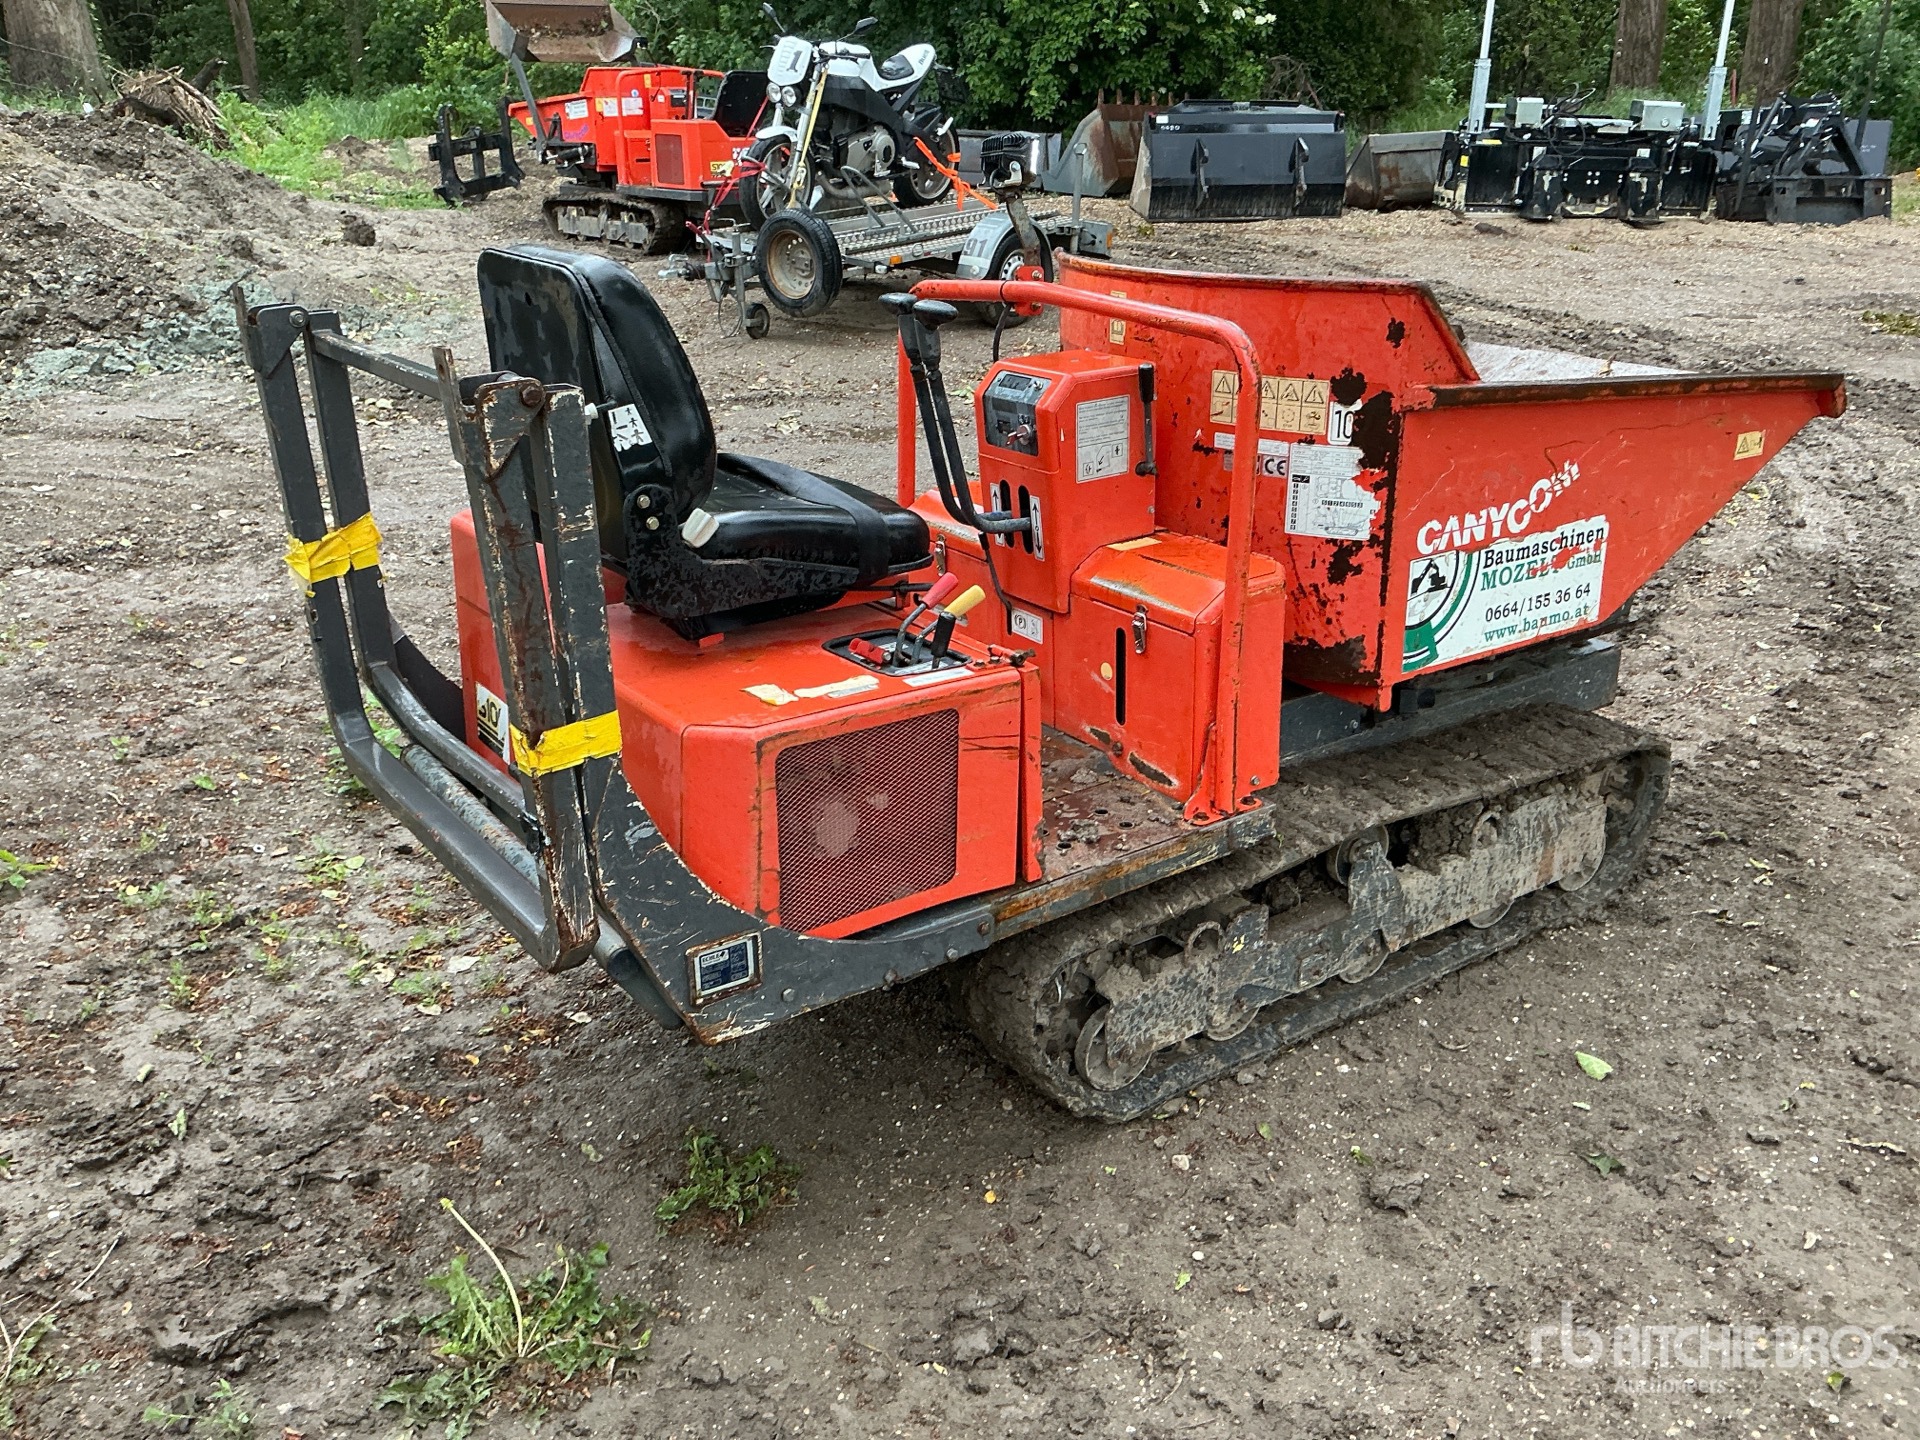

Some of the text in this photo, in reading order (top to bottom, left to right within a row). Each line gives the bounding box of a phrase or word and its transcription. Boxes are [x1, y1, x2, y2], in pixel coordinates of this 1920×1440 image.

[1482, 527, 1604, 570] Baumaschinen
[1485, 582, 1591, 622] 0664/155 36 64
[1483, 603, 1590, 643] www.baumo.at
